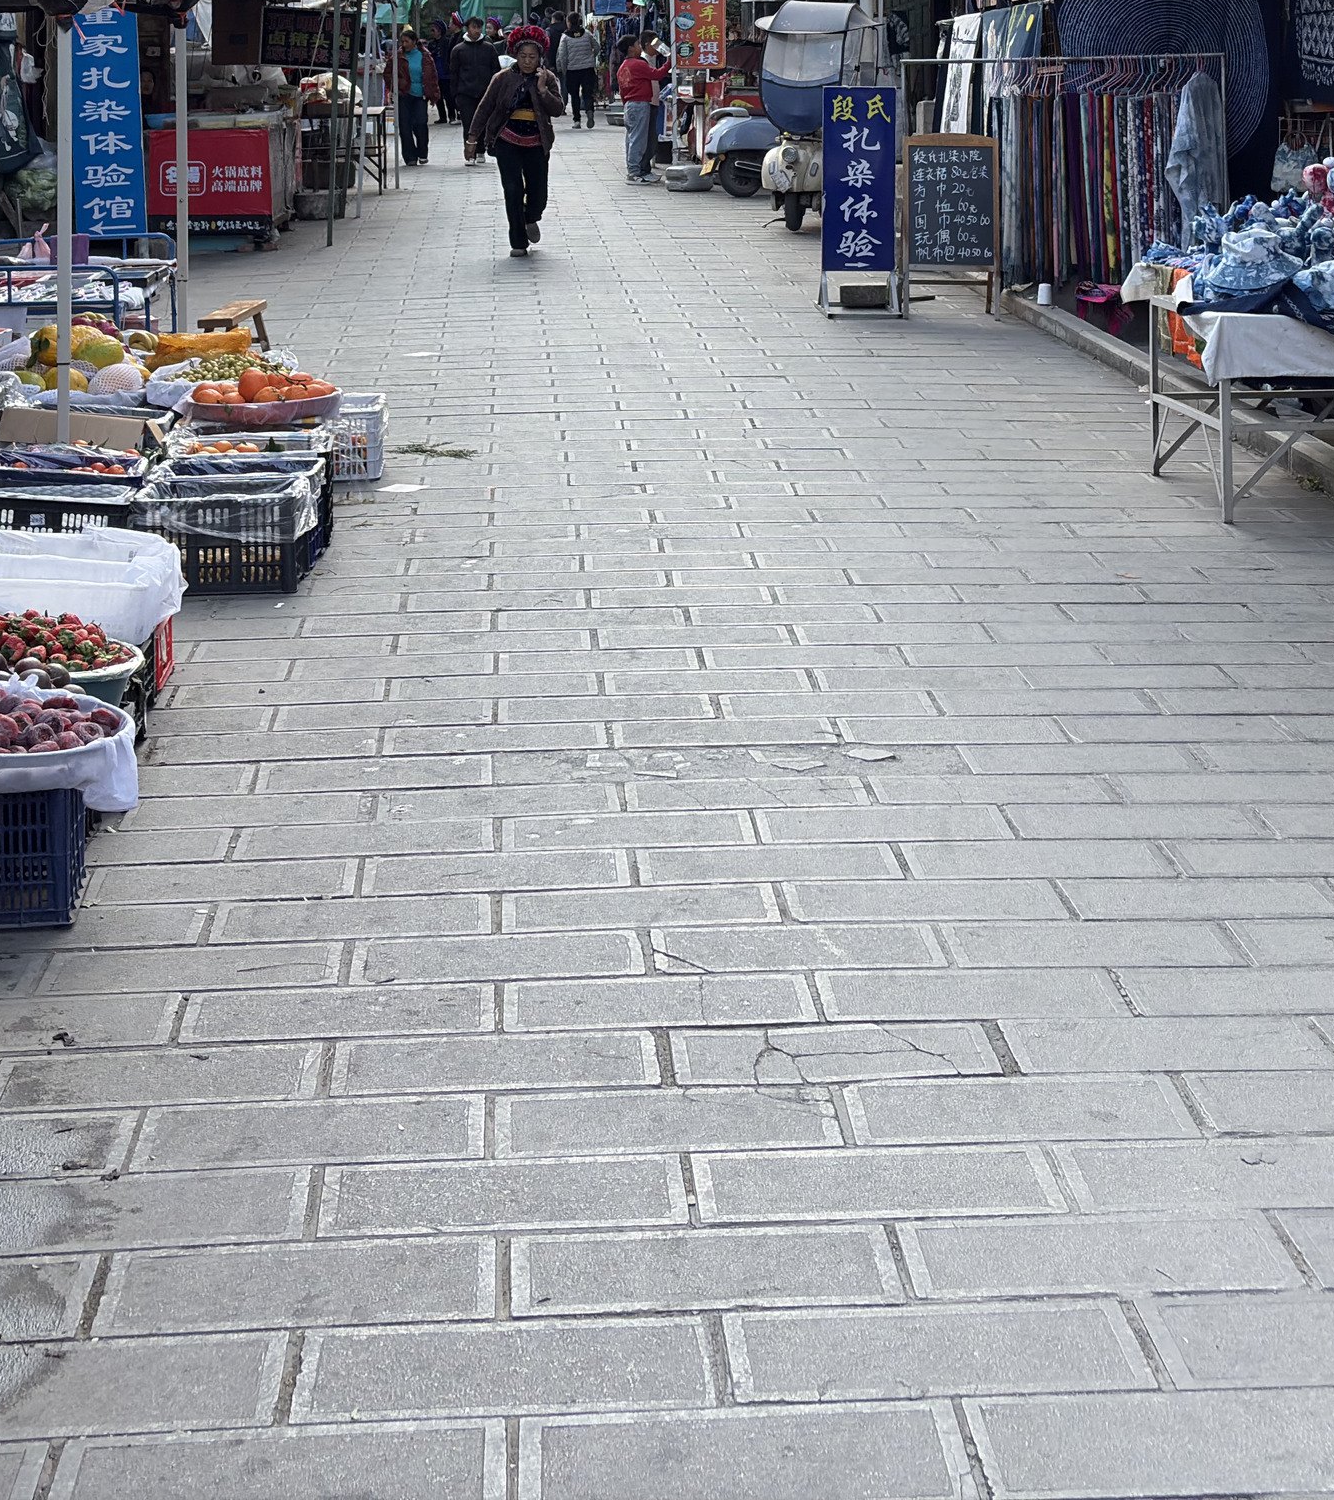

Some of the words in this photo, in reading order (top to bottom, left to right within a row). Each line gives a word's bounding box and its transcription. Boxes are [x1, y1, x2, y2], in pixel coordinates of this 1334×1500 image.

[830, 94, 892, 124] 段氏
[211, 166, 263, 179] 火锅底料
[211, 180, 263, 193] 高端品牌
[835, 125, 883, 258] 扎染体验
